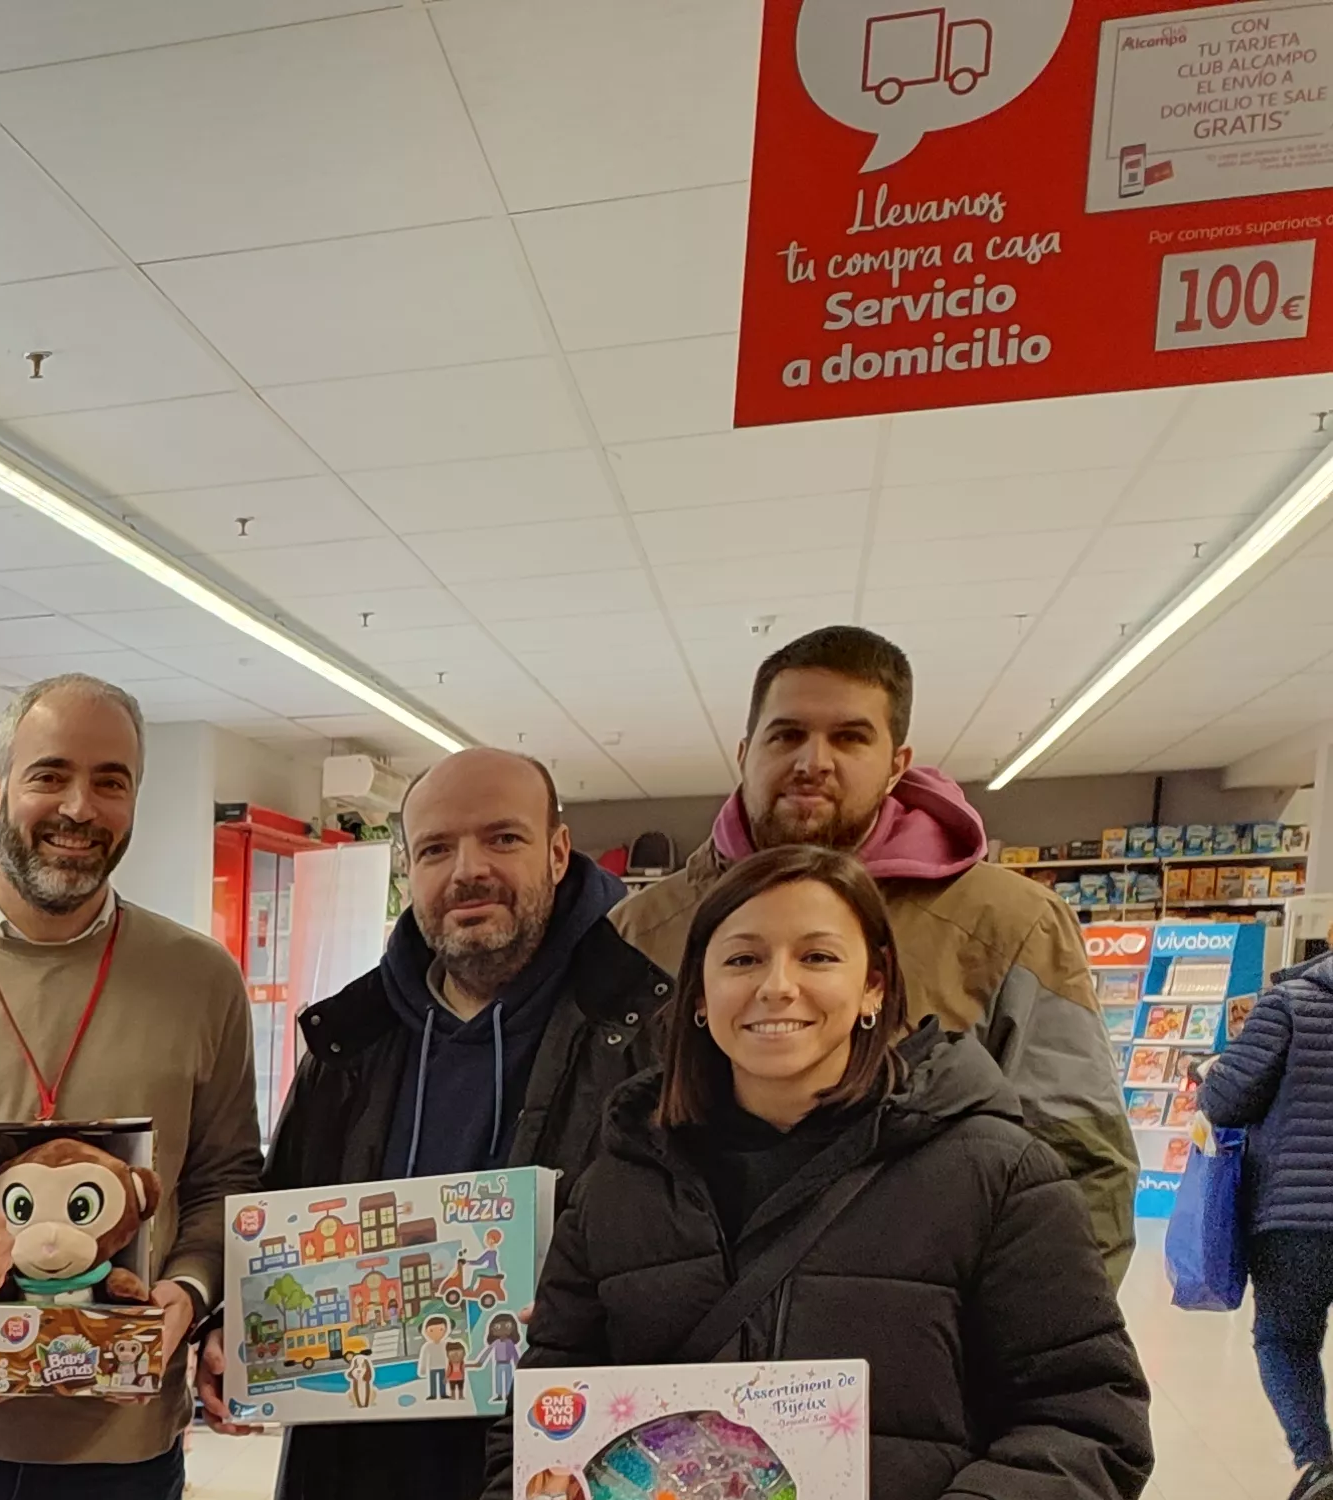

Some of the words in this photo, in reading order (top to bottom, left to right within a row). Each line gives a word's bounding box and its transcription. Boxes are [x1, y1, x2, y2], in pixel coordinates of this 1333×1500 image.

[1231, 17, 1270, 35] CON
[1121, 34, 1187, 50] Alcampo
[1198, 42, 1221, 58] TU
[1226, 32, 1300, 54] TARJETA
[1177, 60, 1223, 79] CLUB
[1228, 49, 1317, 74] ALCAMPO
[1196, 80, 1214, 96] EL
[1222, 68, 1277, 92] ENVÍO
[1281, 70, 1294, 85] A
[1160, 95, 1253, 119] DOMICILIO
[1258, 92, 1278, 108] TE
[1284, 86, 1329, 106] SALE
[846, 183, 1007, 236] Llevamos
[1148, 230, 1174, 244] Por
[1177, 224, 1242, 241] compras
[1246, 214, 1322, 236] superiores
[777, 241, 817, 284] tu
[828, 243, 943, 288] compra
[953, 242, 975, 264] a
[986, 228, 1063, 265] casa
[823, 275, 1018, 331] Servicio
[1175, 260, 1306, 333] 100€
[782, 357, 812, 388] a
[821, 325, 1052, 385] domicilio
[1156, 932, 1233, 951] vivabox
[443, 1182, 469, 1202] my
[43, 1363, 93, 1382] Friends
[48, 1353, 85, 1368] Baby
[541, 1394, 573, 1406] ONE
[739, 1378, 833, 1403] Assortiment
[837, 1372, 856, 1388] de
[541, 1405, 574, 1417] TWO
[544, 1415, 574, 1427] FUN
